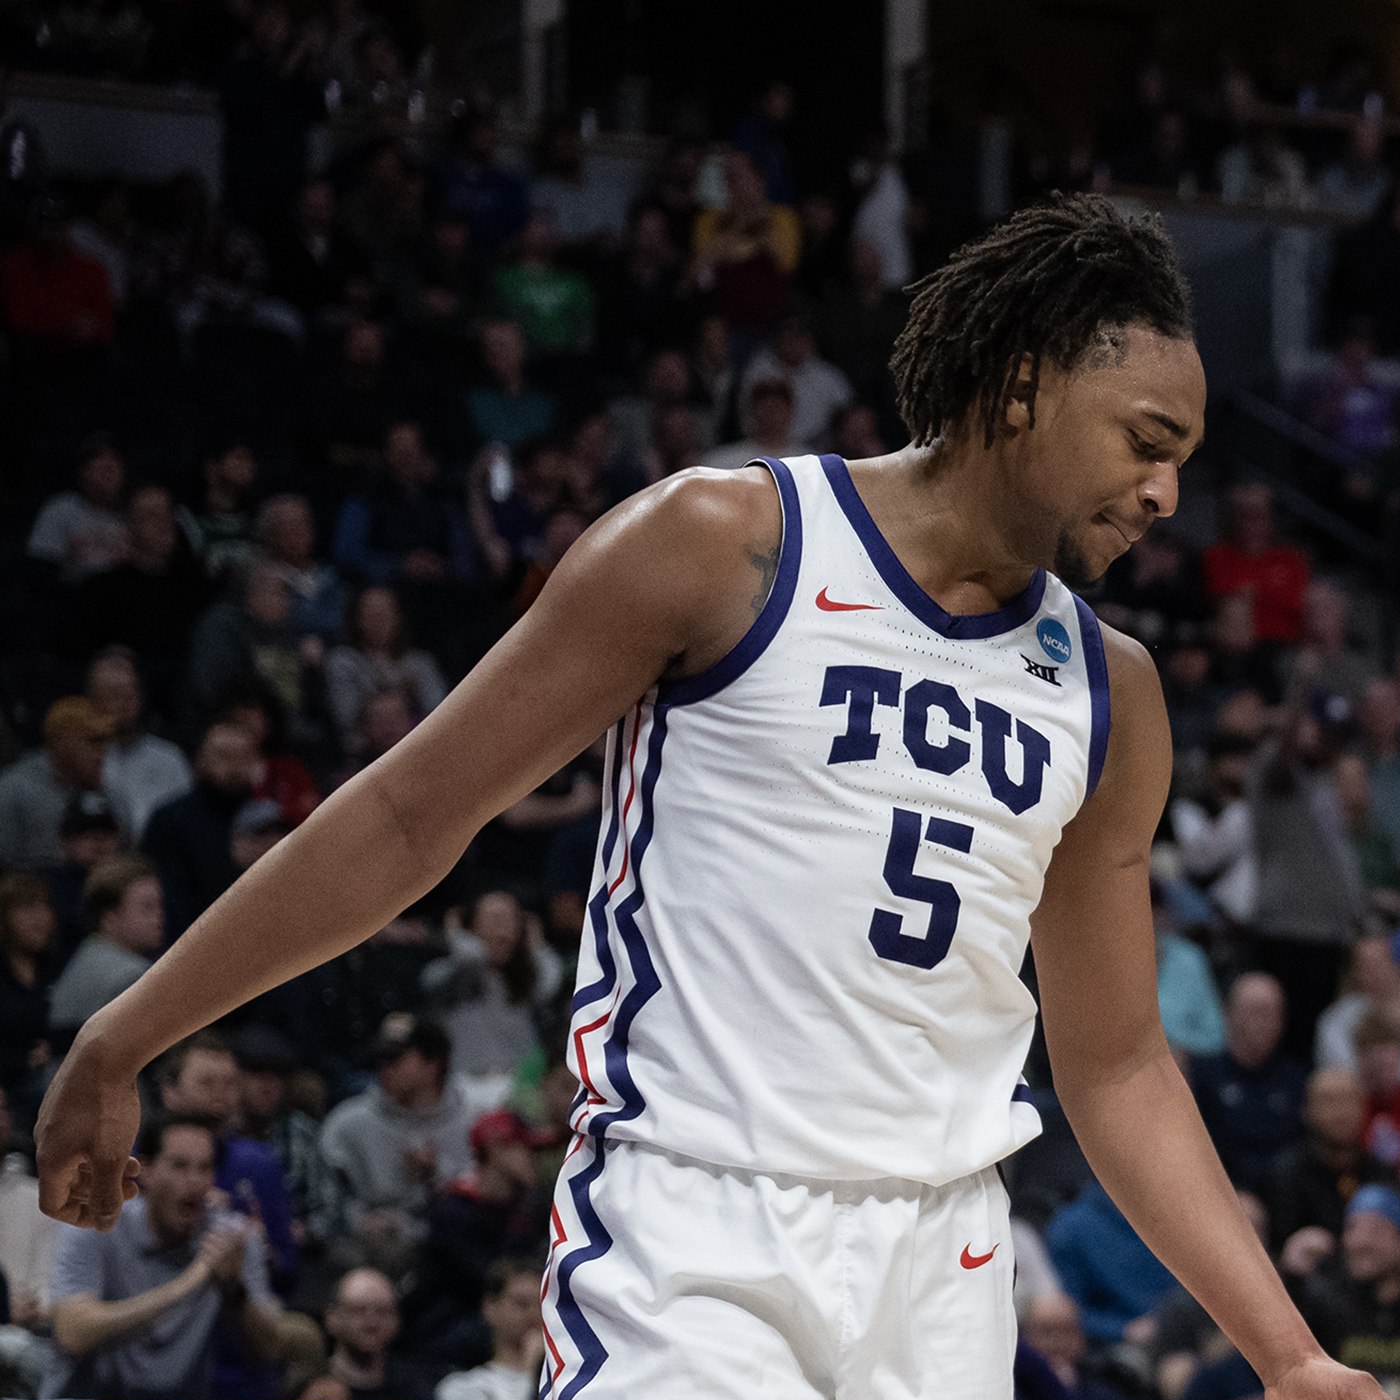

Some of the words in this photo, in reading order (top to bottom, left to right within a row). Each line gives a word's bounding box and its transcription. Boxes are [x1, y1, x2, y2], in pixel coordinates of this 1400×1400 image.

[1019, 651, 1063, 688] XII
[1043, 633, 1070, 657] NCAA
[818, 665, 1052, 817] TCU
[867, 806, 975, 971] 5
